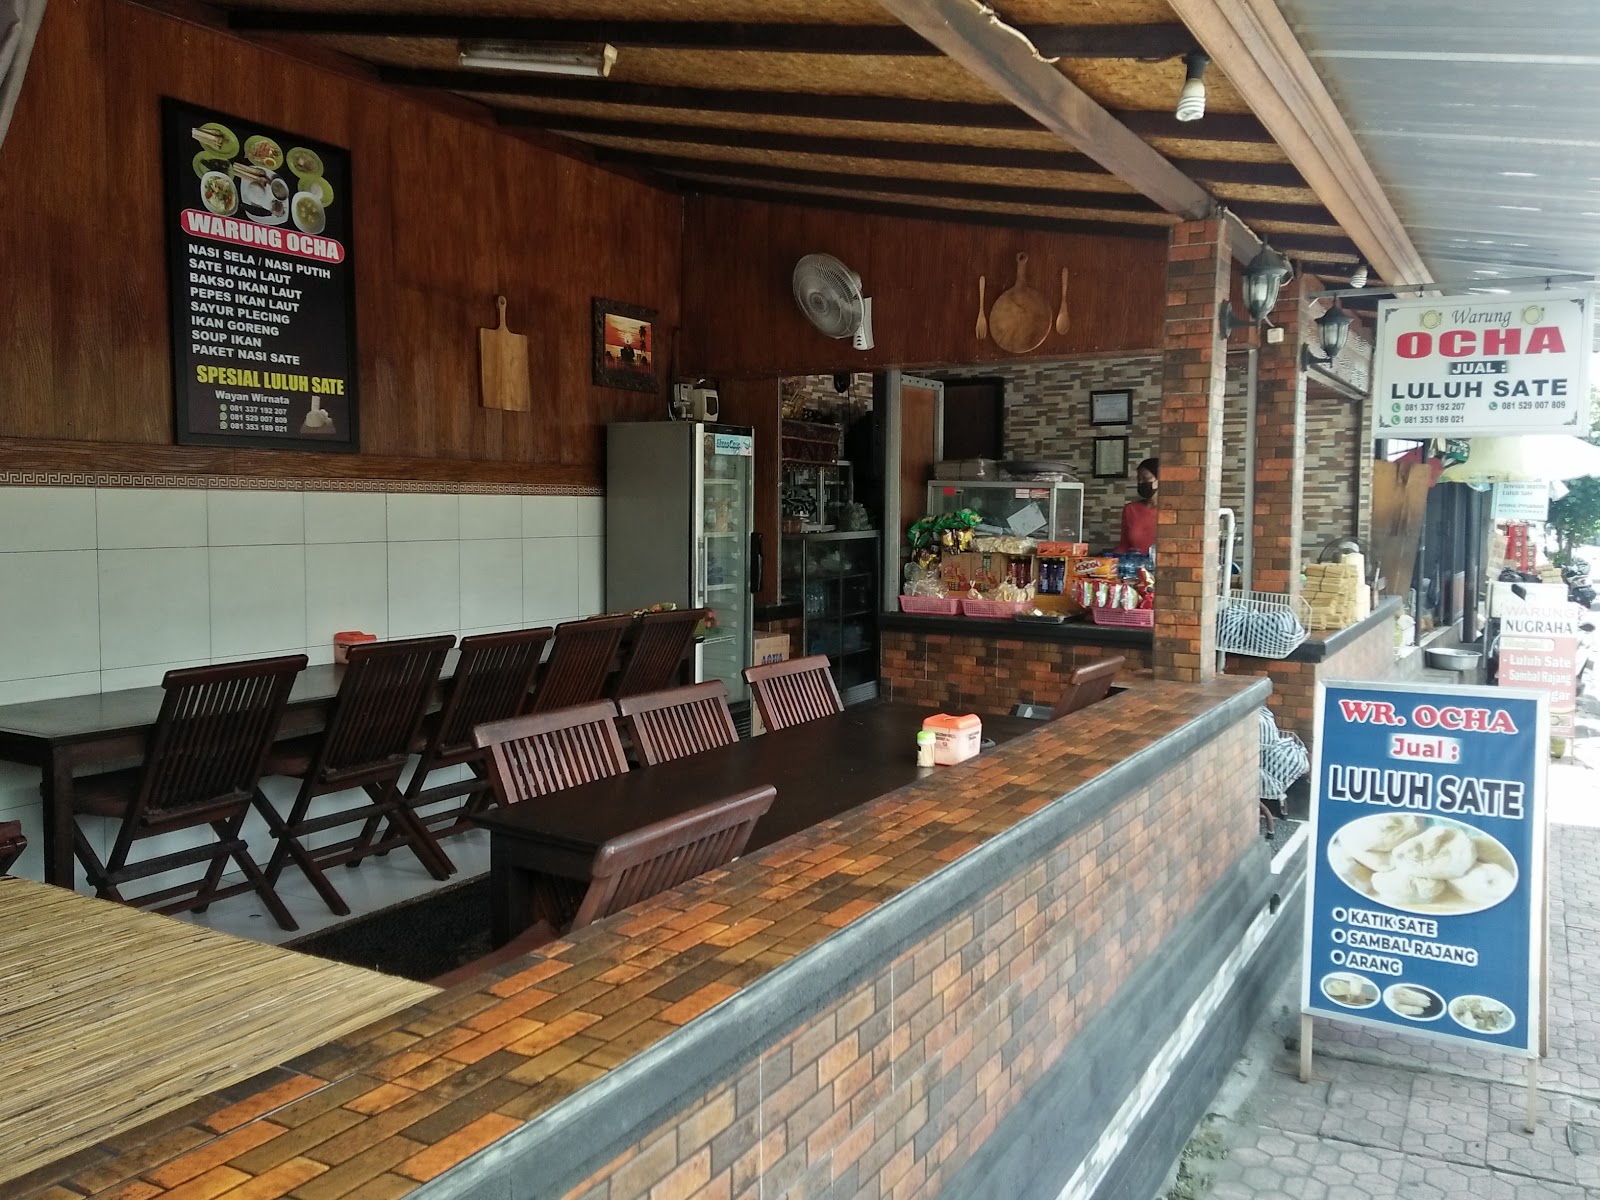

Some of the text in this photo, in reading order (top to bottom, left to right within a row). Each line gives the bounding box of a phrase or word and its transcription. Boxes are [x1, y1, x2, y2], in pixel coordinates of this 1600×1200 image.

[187, 211, 340, 260] WARUNG OCHA
[188, 243, 219, 259] NASI
[223, 250, 255, 265] SELA
[265, 258, 293, 272] NASI
[296, 264, 331, 279] PUTIH
[189, 258, 291, 285] SATE IKAN LAUT
[189, 272, 302, 300] BAKSO IKAN LAUT
[190, 286, 299, 313] PEPES IKAN LAUT
[190, 301, 290, 325] SAYUR PLECING
[1451, 307, 1512, 327] Warung
[191, 315, 279, 336] IKAN GORENG
[191, 329, 262, 348] SOUP IKAN
[1396, 326, 1566, 359] OCHA
[192, 343, 300, 365] PAKET NASI SATE
[1452, 362, 1496, 374] JUAL
[196, 364, 344, 395] SPESIAL LULUH SATE
[1391, 378, 1568, 399] LULUH SATE
[215, 390, 290, 405] Wayan Wirnata
[1405, 402, 1465, 411] 081 337 192 207
[1535, 401, 1548, 409] 007
[1551, 401, 1566, 409] 809
[229, 404, 243, 412] 081
[245, 405, 258, 413] 337
[260, 406, 273, 414] 192
[1404, 416, 1417, 424] 081
[1436, 415, 1449, 423] 189
[1451, 415, 1464, 423] 021
[230, 422, 243, 430] 081
[245, 423, 259, 431] 353
[260, 424, 273, 432] 189
[1505, 606, 1576, 618] WARUNG
[1506, 620, 1573, 634] NUGRAHA
[1510, 654, 1571, 668] Luluh Sate
[1509, 669, 1571, 686] Sambal Rajang
[1339, 700, 1518, 735] WR. OCHA
[1392, 737, 1443, 759] Jual
[1330, 766, 1524, 819] LULUH SATE
[1351, 911, 1435, 935] KATIK SATE
[1350, 932, 1475, 964] SAMBAL RAJANG
[1349, 954, 1400, 973] ARANG
